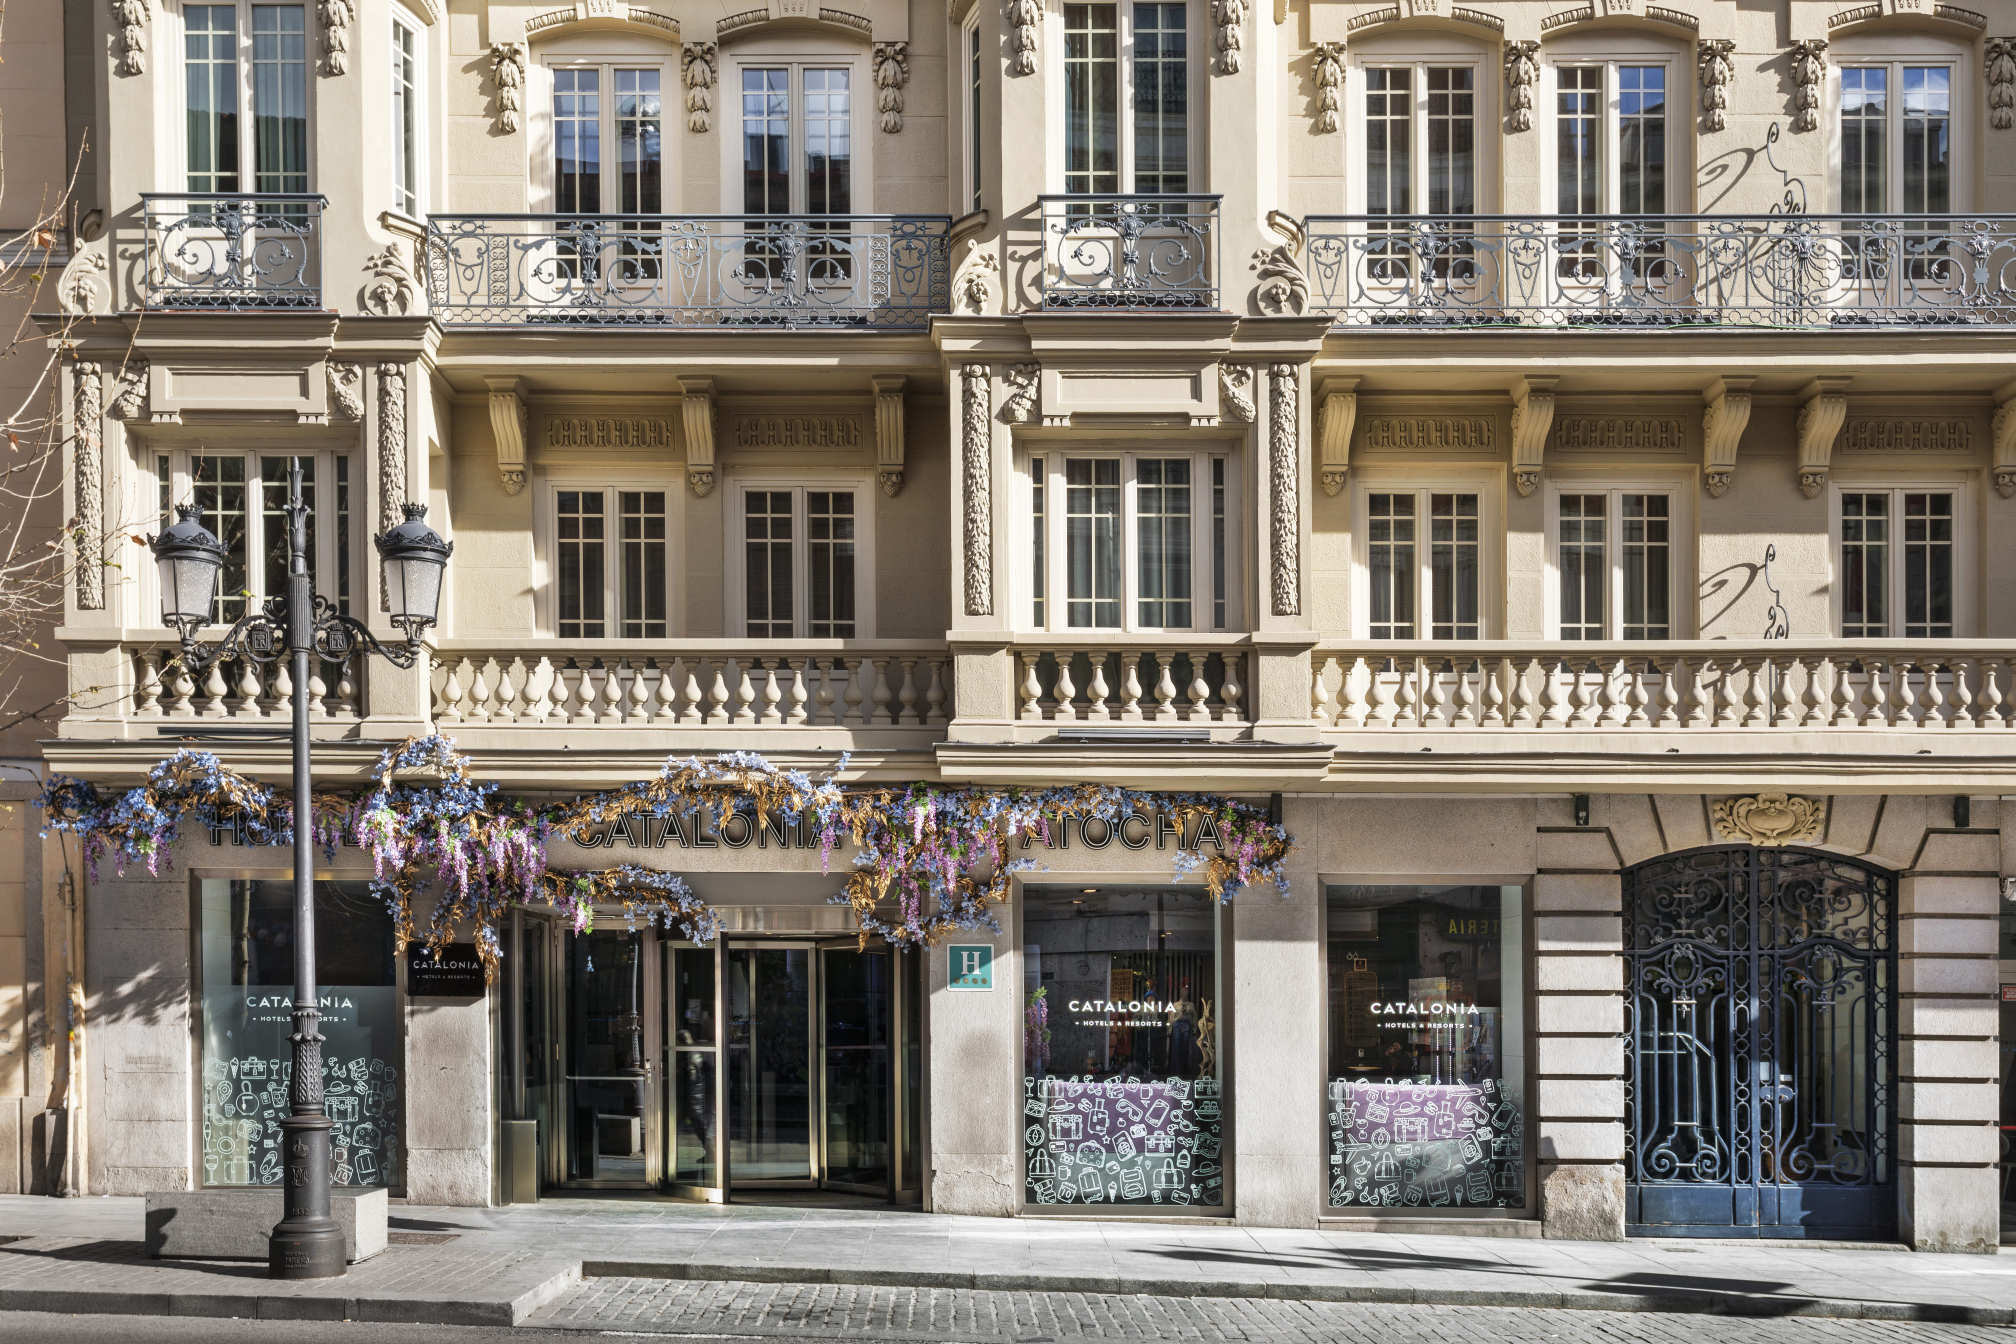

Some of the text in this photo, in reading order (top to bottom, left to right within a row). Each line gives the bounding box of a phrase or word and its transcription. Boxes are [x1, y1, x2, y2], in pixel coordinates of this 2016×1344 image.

[1021, 812, 1225, 850] ATOCHA
[413, 960, 479, 969] CATALONIA
[960, 951, 982, 975] H
[246, 996, 353, 1008] CATANIA
[1068, 1000, 1177, 1013] CATALONIA
[1370, 1002, 1479, 1015] CATALONIA
